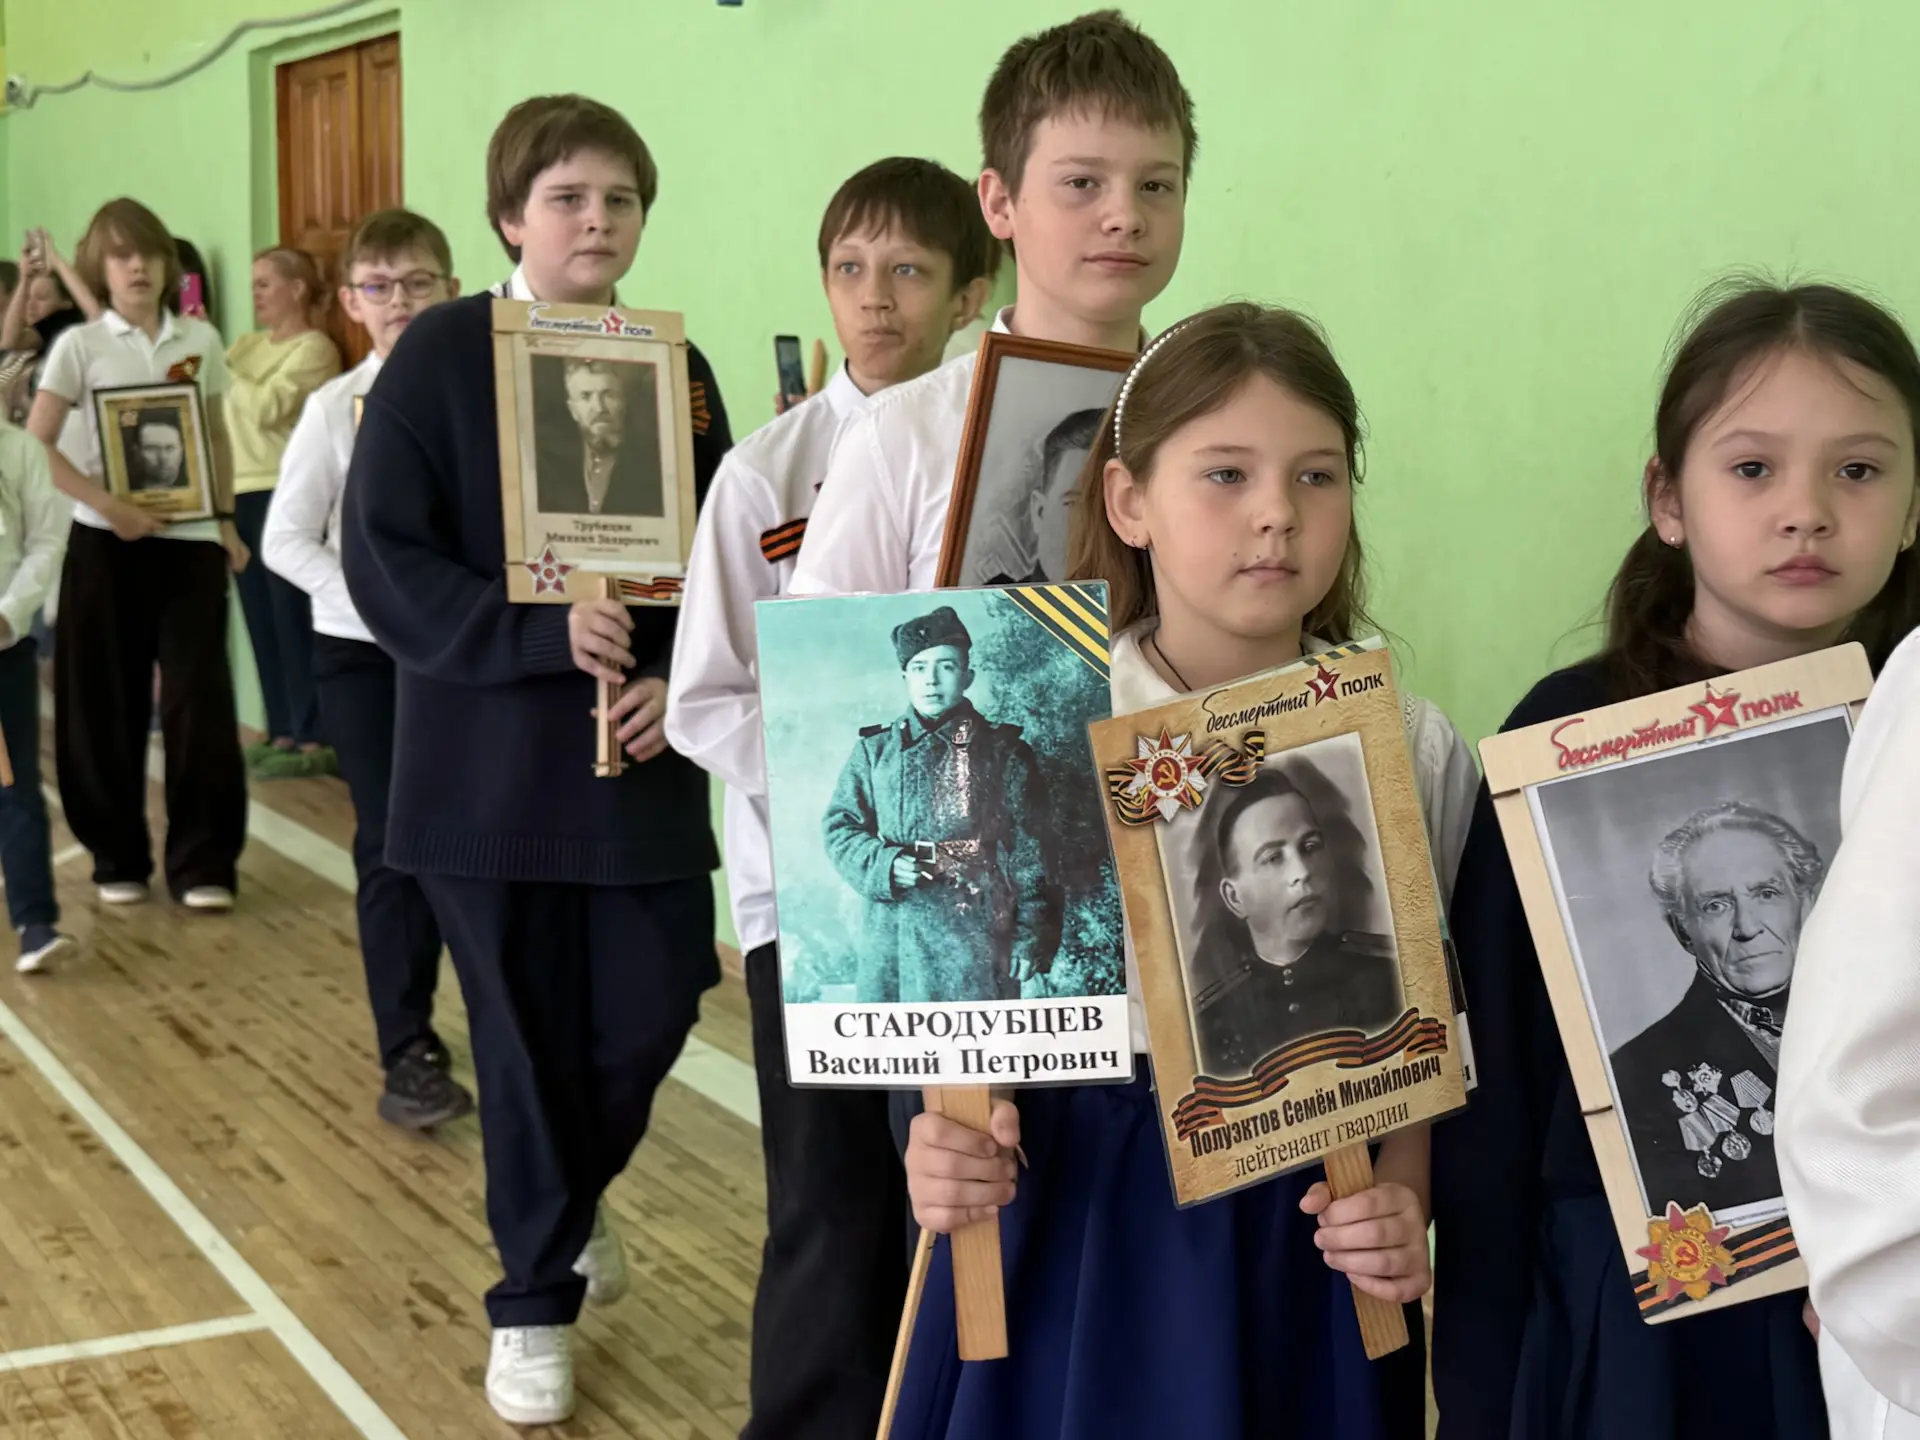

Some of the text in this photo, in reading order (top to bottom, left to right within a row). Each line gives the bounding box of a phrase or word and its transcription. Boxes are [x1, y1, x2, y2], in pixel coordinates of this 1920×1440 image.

[833, 1005, 1104, 1043] СТАРОДУБЦЕВ
[807, 1048, 1119, 1079] Василий Петрович
[1189, 1055, 1442, 1158] Полуэктов Семён Михайлович
[1234, 1101, 1411, 1178] лейтенант гвардии
